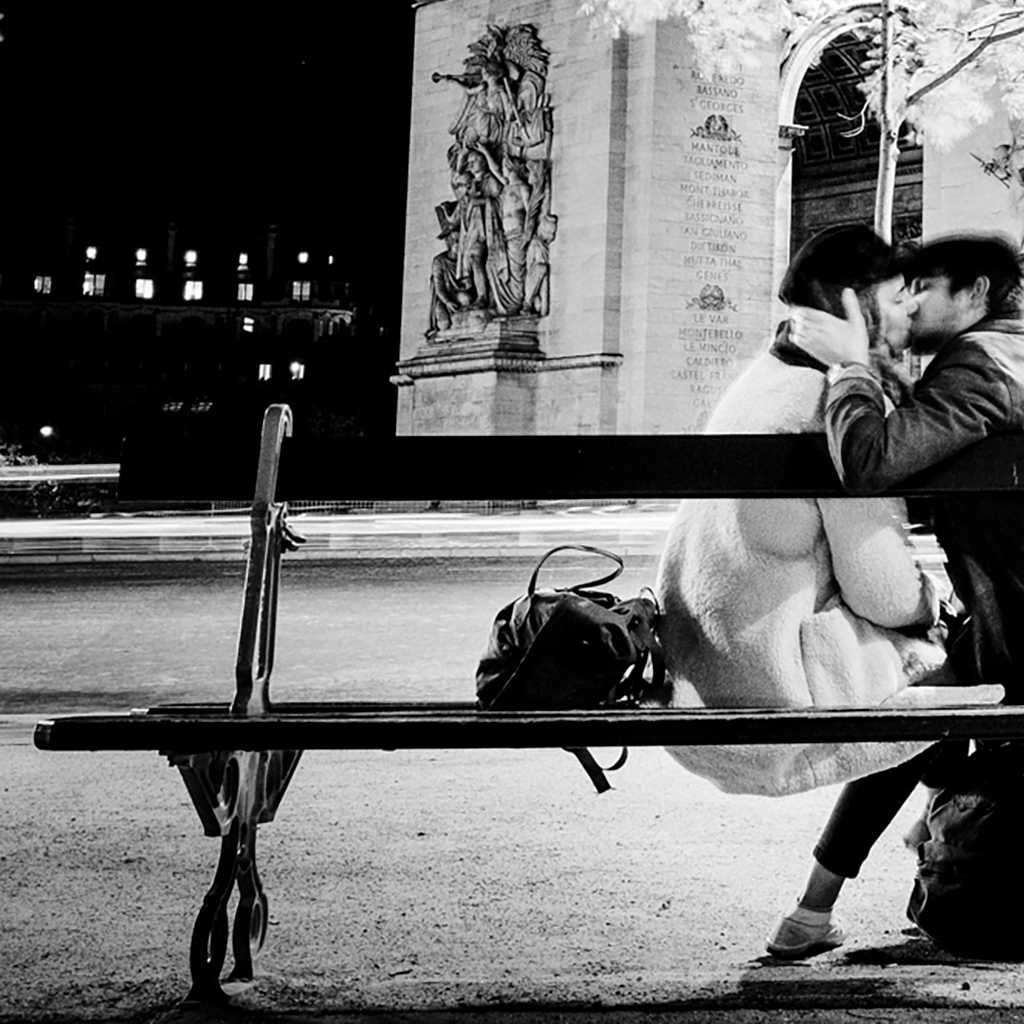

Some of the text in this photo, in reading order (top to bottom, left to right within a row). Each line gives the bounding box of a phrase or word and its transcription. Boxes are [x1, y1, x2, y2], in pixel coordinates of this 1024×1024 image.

[696, 85, 739, 99] BASSANO
[699, 99, 745, 114] GEORGES
[690, 142, 741, 157] MANTOUE
[693, 170, 737, 184] SEDIMAN
[680, 183, 709, 195] MONT
[694, 313, 729, 325] LE VAR
[678, 327, 743, 341] MONTEBELLO
[683, 342, 737, 355] LE MINCIO
[686, 356, 735, 368] CALDIERO
[670, 369, 706, 382] CASTEL
